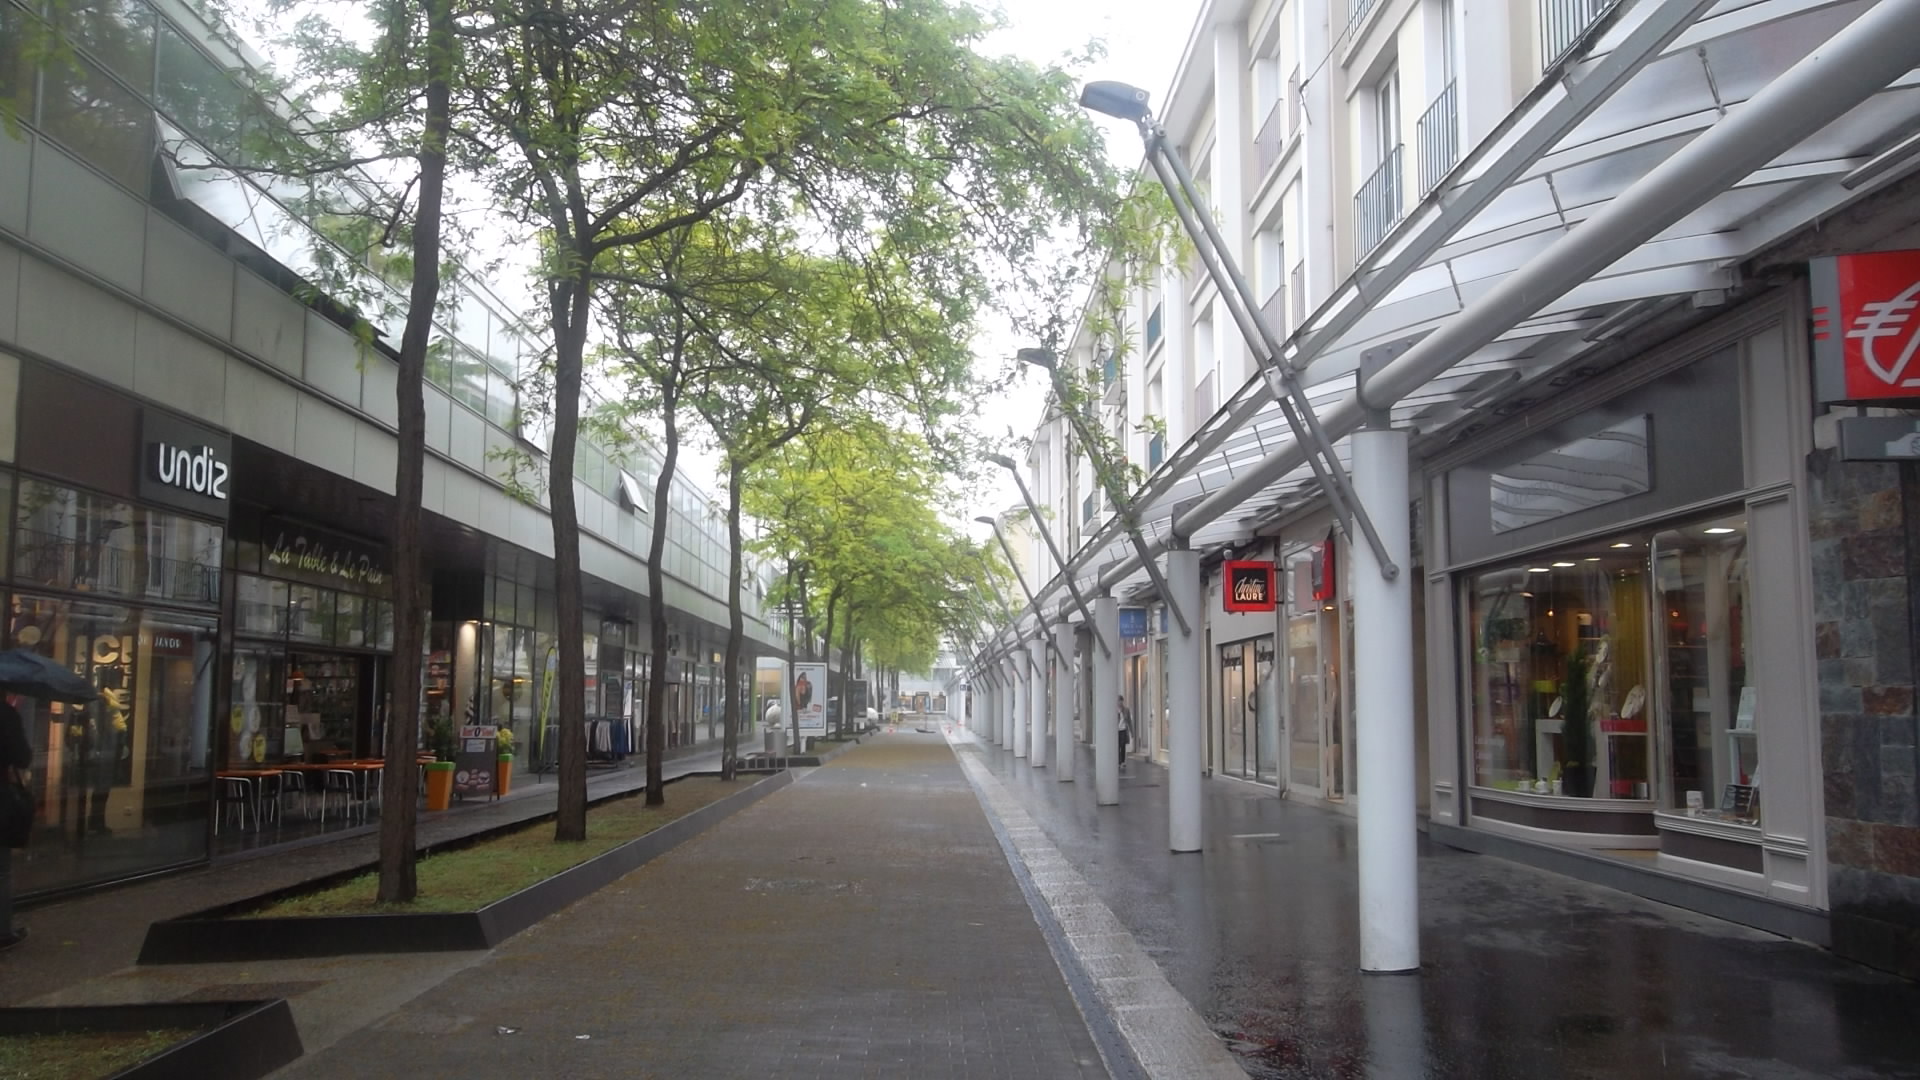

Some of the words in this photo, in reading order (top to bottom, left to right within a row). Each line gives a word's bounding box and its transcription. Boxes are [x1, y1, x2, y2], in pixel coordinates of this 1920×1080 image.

[159, 442, 228, 500] undiz
[268, 531, 291, 565] La
[330, 550, 340, 575] &
[339, 549, 356, 579] Le
[1235, 592, 1264, 601] LAURE
